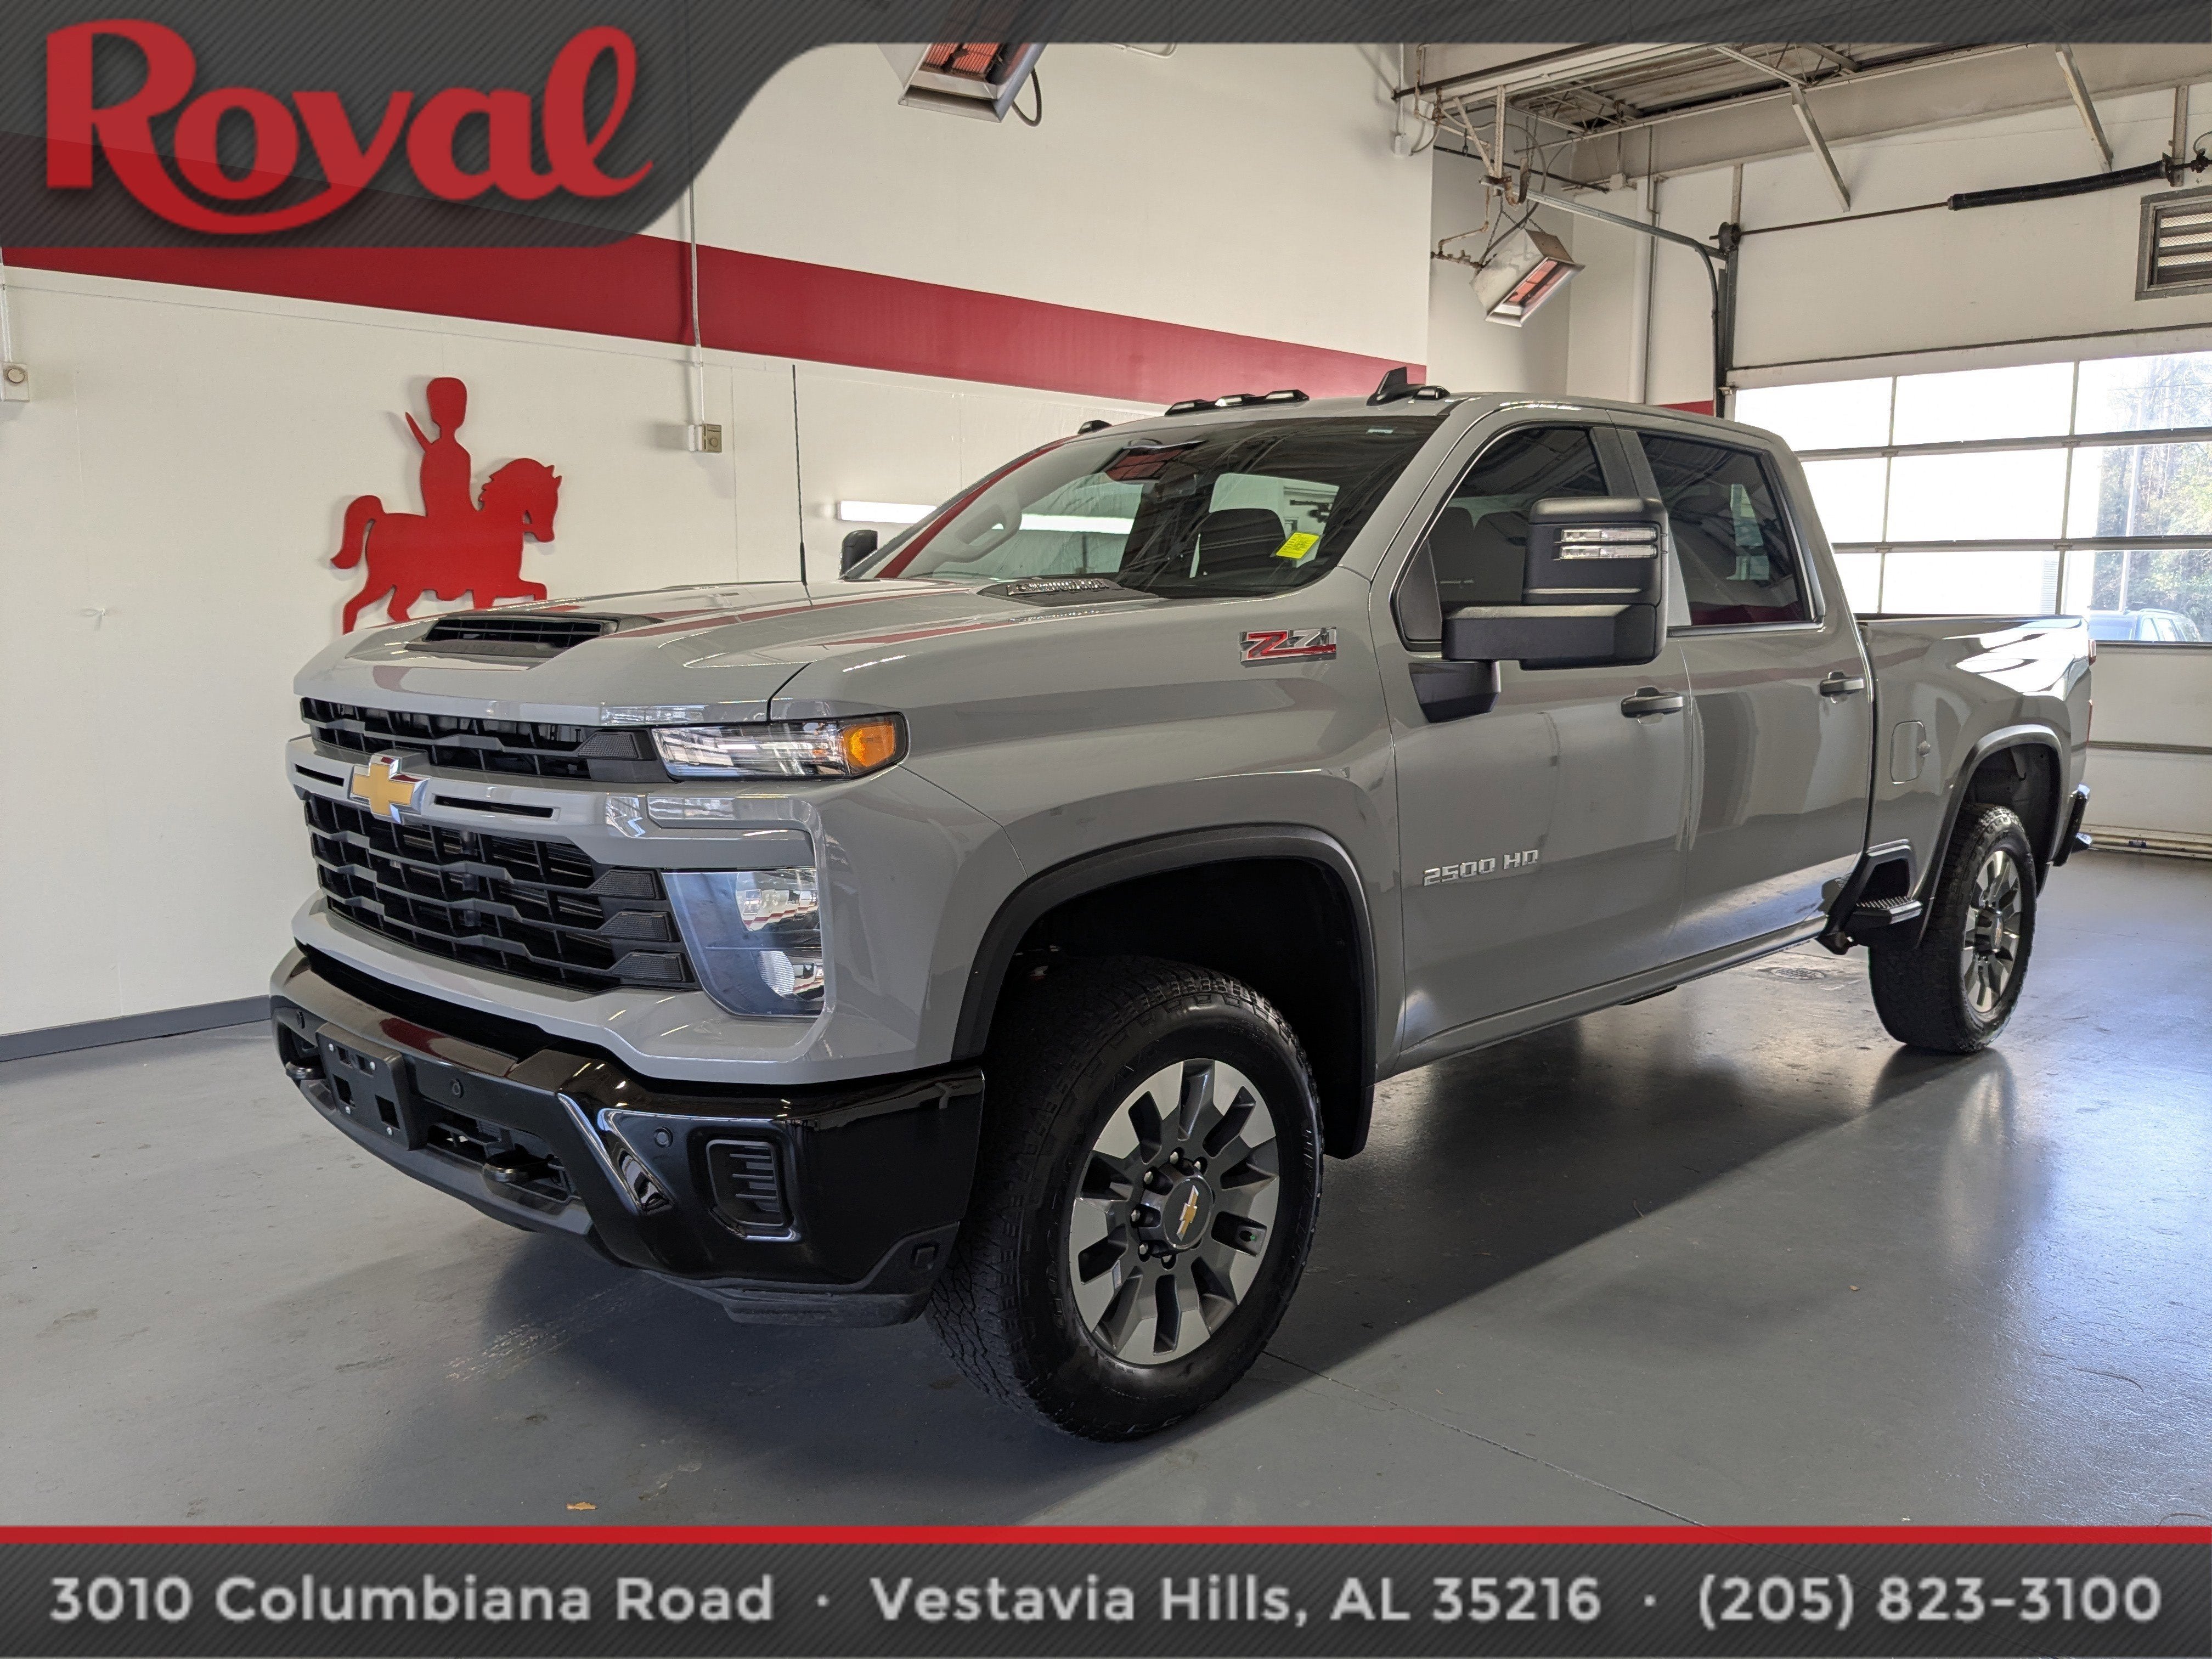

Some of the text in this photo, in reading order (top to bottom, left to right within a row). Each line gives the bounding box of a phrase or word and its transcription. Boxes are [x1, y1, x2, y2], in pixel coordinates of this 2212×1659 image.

[1240, 627, 1337, 667] Z71
[1423, 849, 1538, 887] 2500 HD
